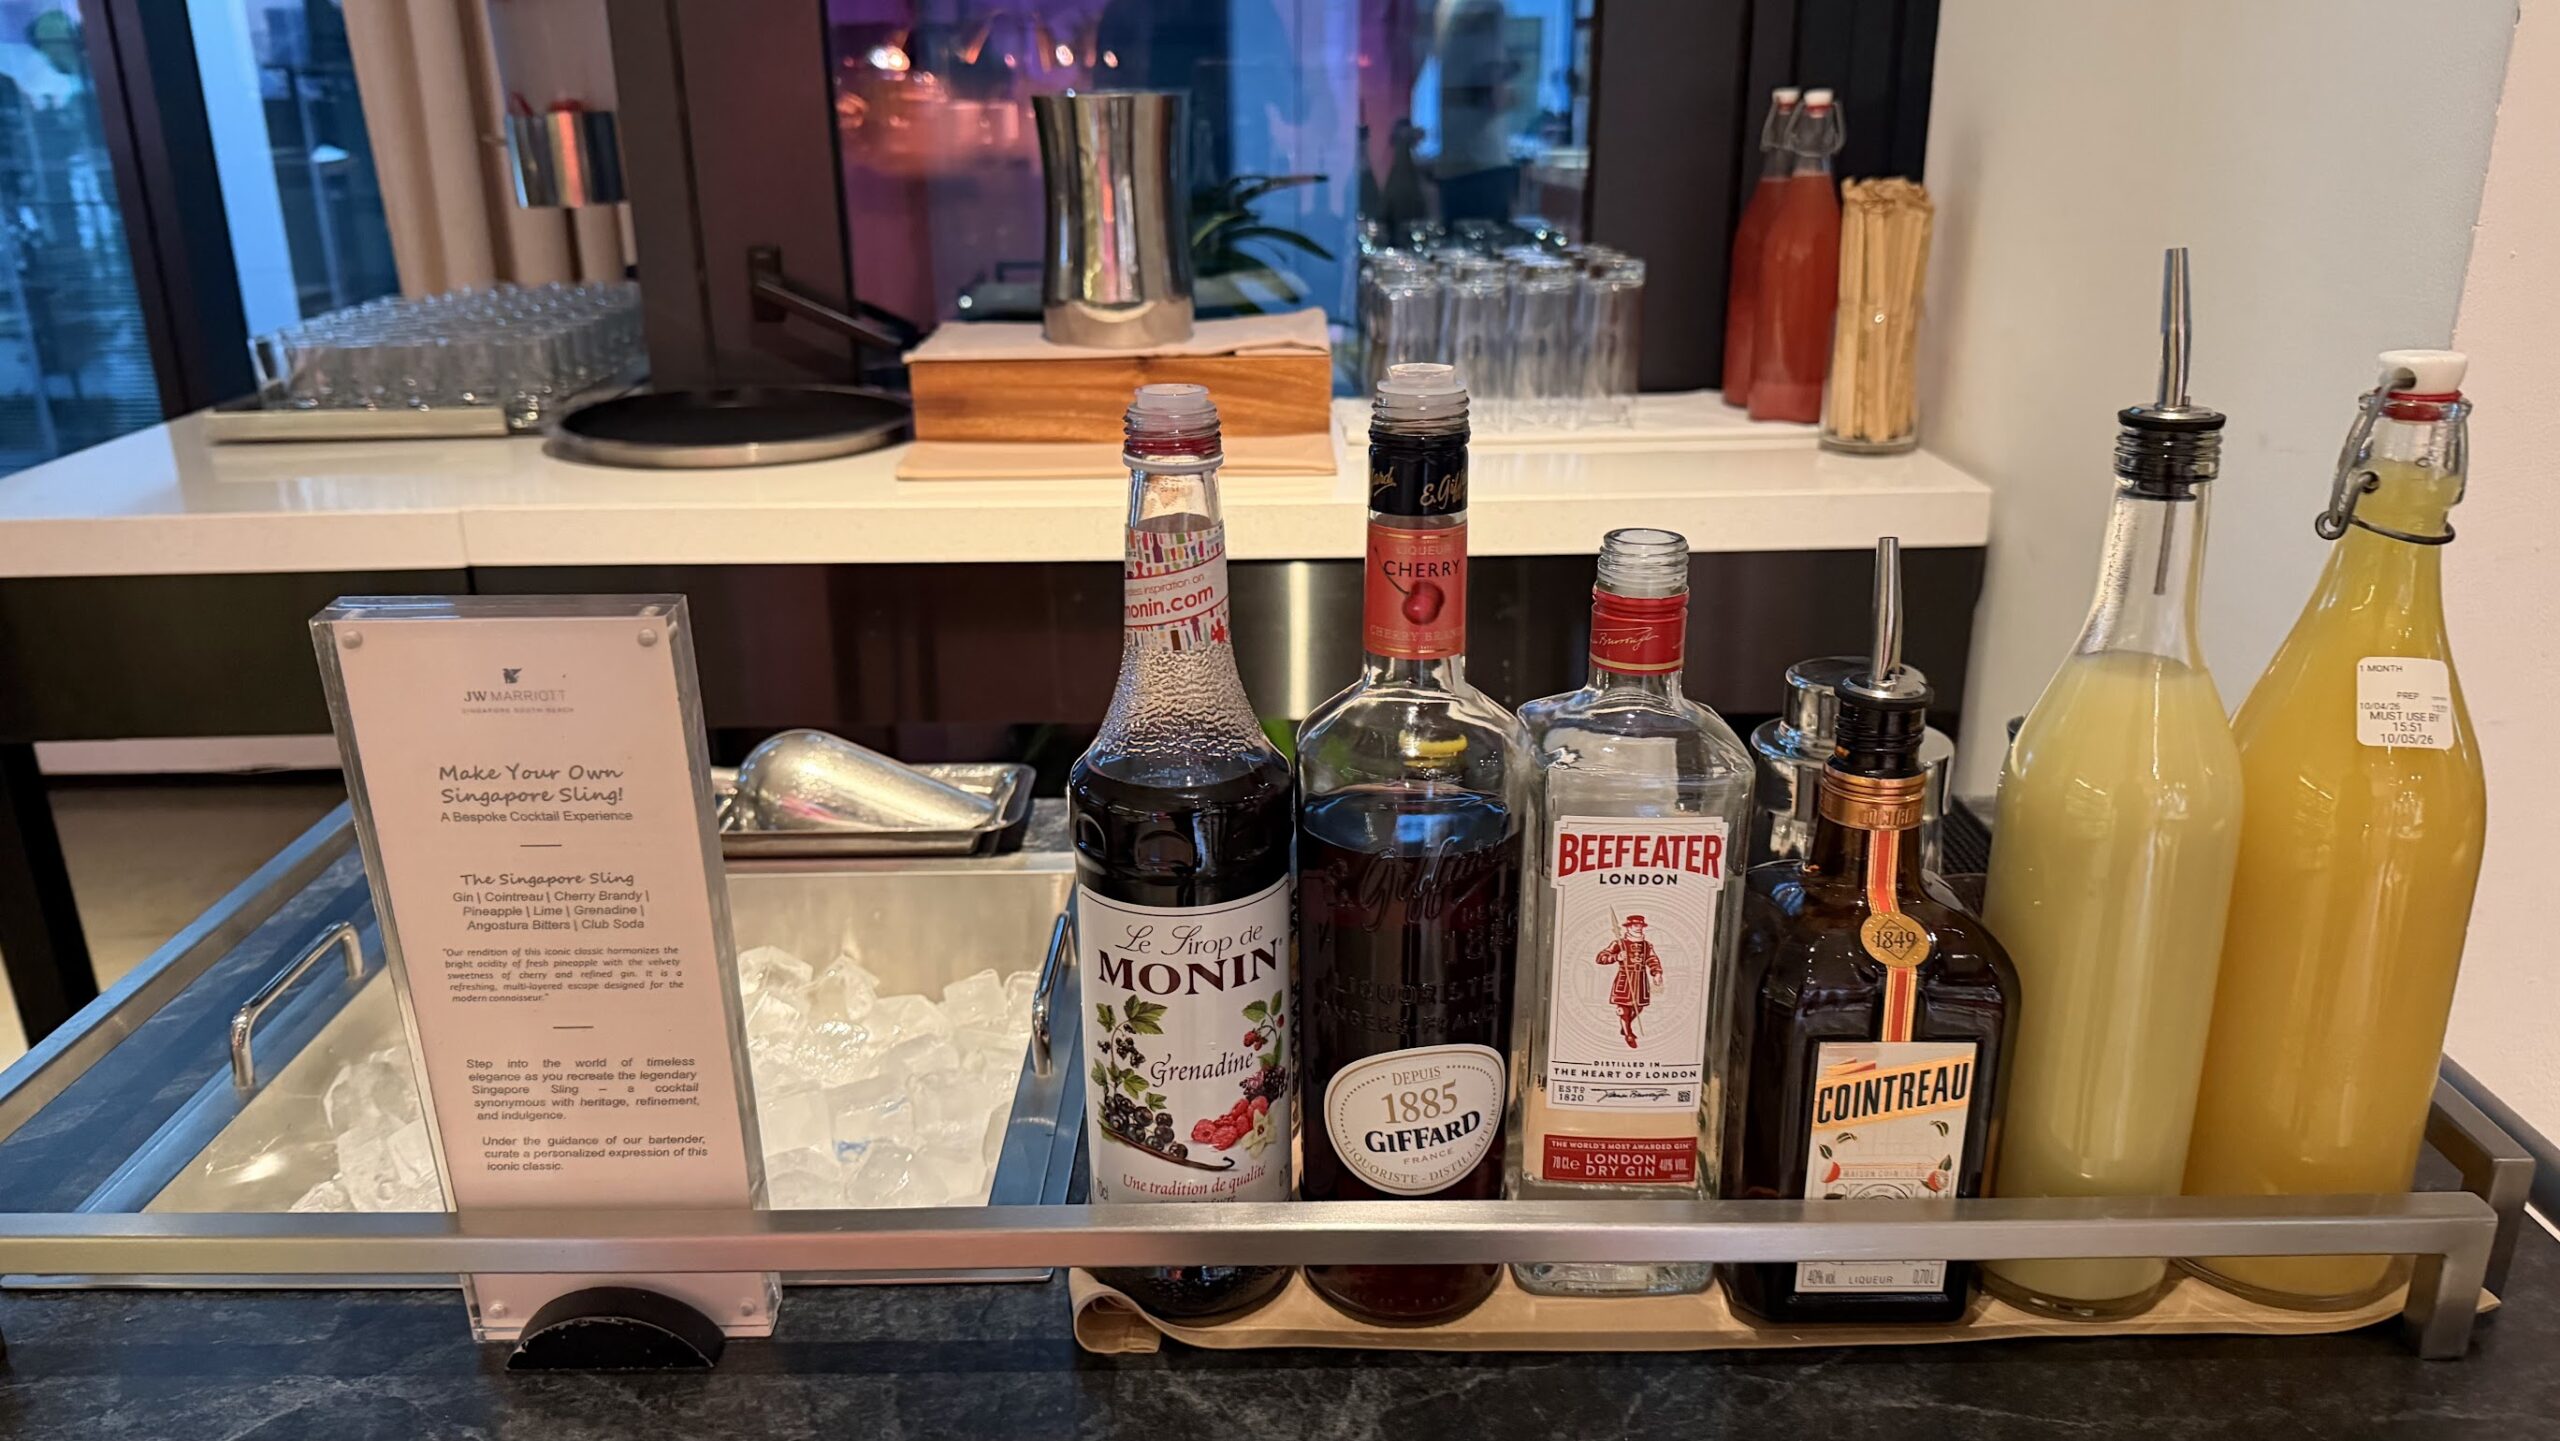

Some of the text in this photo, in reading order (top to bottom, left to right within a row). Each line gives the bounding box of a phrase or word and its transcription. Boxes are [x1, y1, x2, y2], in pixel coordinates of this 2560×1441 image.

[1383, 560, 1460, 578] CHERRY
[1144, 578, 1190, 594] inspiration
[1193, 573, 1204, 584] on
[1369, 625, 1418, 642] CHERRY
[464, 689, 566, 702] JW MARRIOTT
[2397, 691, 2419, 700] PREP
[2370, 711, 2440, 722] MUST USE BY
[2393, 722, 2422, 732] 15:51
[2380, 733, 2434, 745] 10/05/26
[439, 763, 624, 781] Make Your Own
[441, 786, 623, 806] Singapore Sling!
[440, 810, 633, 824] A Bespoke Cocktail Experience
[1558, 833, 1722, 879] BEEFEATER
[459, 872, 634, 888] The Singapore Sling
[1600, 873, 1678, 885] LONDON
[452, 890, 643, 903] Gin Cointreau Cherry Brandy
[463, 905, 638, 918] Pineapple Lime Grenadine
[466, 918, 645, 933] Angostura Bitters Club Soda
[1115, 924, 1263, 959] Le Sirop de
[1875, 930, 1917, 949] 1849
[467, 948, 508, 957] rendition
[511, 947, 522, 958] of
[524, 947, 541, 956] this
[544, 947, 571, 956] iconic
[573, 947, 604, 956] classic
[606, 947, 660, 955] harmonizes
[663, 946, 679, 954] the
[444, 958, 681, 970] bright acidity of fresh pineapple with the velvety
[1098, 938, 1280, 995] MONIN
[447, 972, 494, 980] sweetness
[501, 971, 512, 981] of
[518, 971, 548, 980] cherry
[554, 970, 573, 979] and
[580, 970, 613, 979] refined
[660, 969, 668, 977] is
[503, 982, 563, 991] multi-layered
[567, 983, 599, 991] escape
[603, 981, 645, 991] designed
[649, 980, 664, 990] for
[669, 980, 684, 989] the
[452, 994, 488, 1003] modern
[466, 1057, 695, 1070] Step into the world of timeless
[1150, 1052, 1253, 1088] Grenadine
[468, 1070, 697, 1084] elegance as you recreate the legendary
[1392, 1066, 1441, 1086] DEPUIS
[1554, 1068, 1697, 1079] THE HEART OF LONDON
[472, 1082, 699, 1097] Singapore Sling a cocktail
[1817, 1063, 1970, 1124] COINTREAU
[474, 1096, 700, 1109] synonymous with heritage, refinement,
[1381, 1079, 1458, 1124] 1885
[1559, 1093, 1584, 1101] 1820
[477, 1110, 566, 1122] and indulgence.
[1364, 1110, 1481, 1153] GIFFARD
[482, 1134, 706, 1147] Under the guidance of our bartender,
[484, 1149, 520, 1159] curate
[533, 1148, 606, 1160] personalized
[608, 1147, 670, 1159] expression
[673, 1147, 685, 1157] of
[687, 1147, 708, 1157] this
[1404, 1149, 1453, 1165] FRANCE
[1586, 1153, 1656, 1165] LONDON
[487, 1161, 564, 1171] iconic classic.
[1343, 1140, 1417, 1184] LIQUORISTE
[1585, 1166, 1656, 1177] DRY GIN
[1123, 1173, 1147, 1192] Une
[1150, 1177, 1208, 1197] tradition
[1211, 1176, 1227, 1192] de
[1229, 1163, 1267, 1194] qualité
[1848, 1275, 1894, 1285] LIQUEUR
